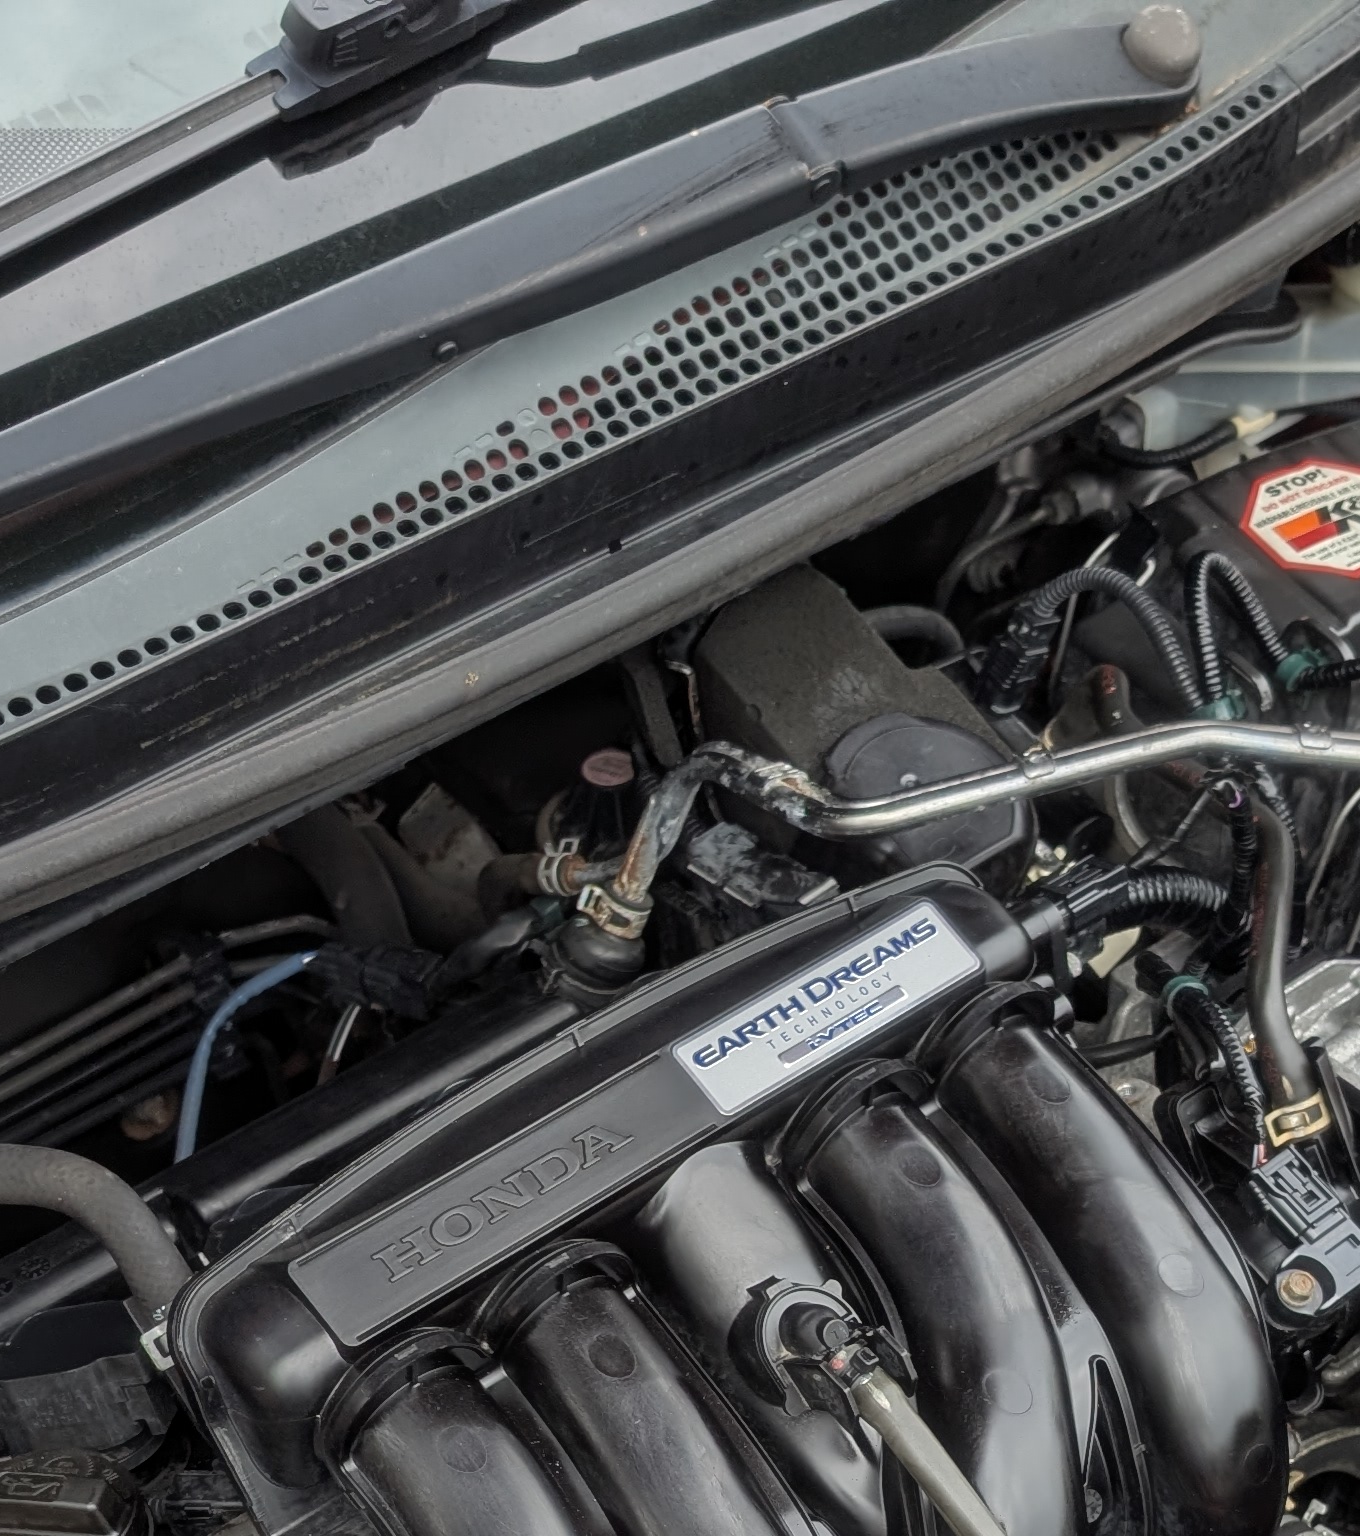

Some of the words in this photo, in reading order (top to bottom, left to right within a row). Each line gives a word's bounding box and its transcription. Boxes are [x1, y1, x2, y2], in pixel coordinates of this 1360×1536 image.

[1261, 501, 1279, 513] DO
[1279, 490, 1302, 506] NOT
[1304, 475, 1350, 496] DISCARD
[1264, 468, 1327, 498] STOP!
[691, 996, 805, 1070] EARTH
[800, 916, 939, 1007] DREAMS
[765, 971, 894, 1049] TECHNOLOGY
[370, 1124, 635, 1283] HONDA
